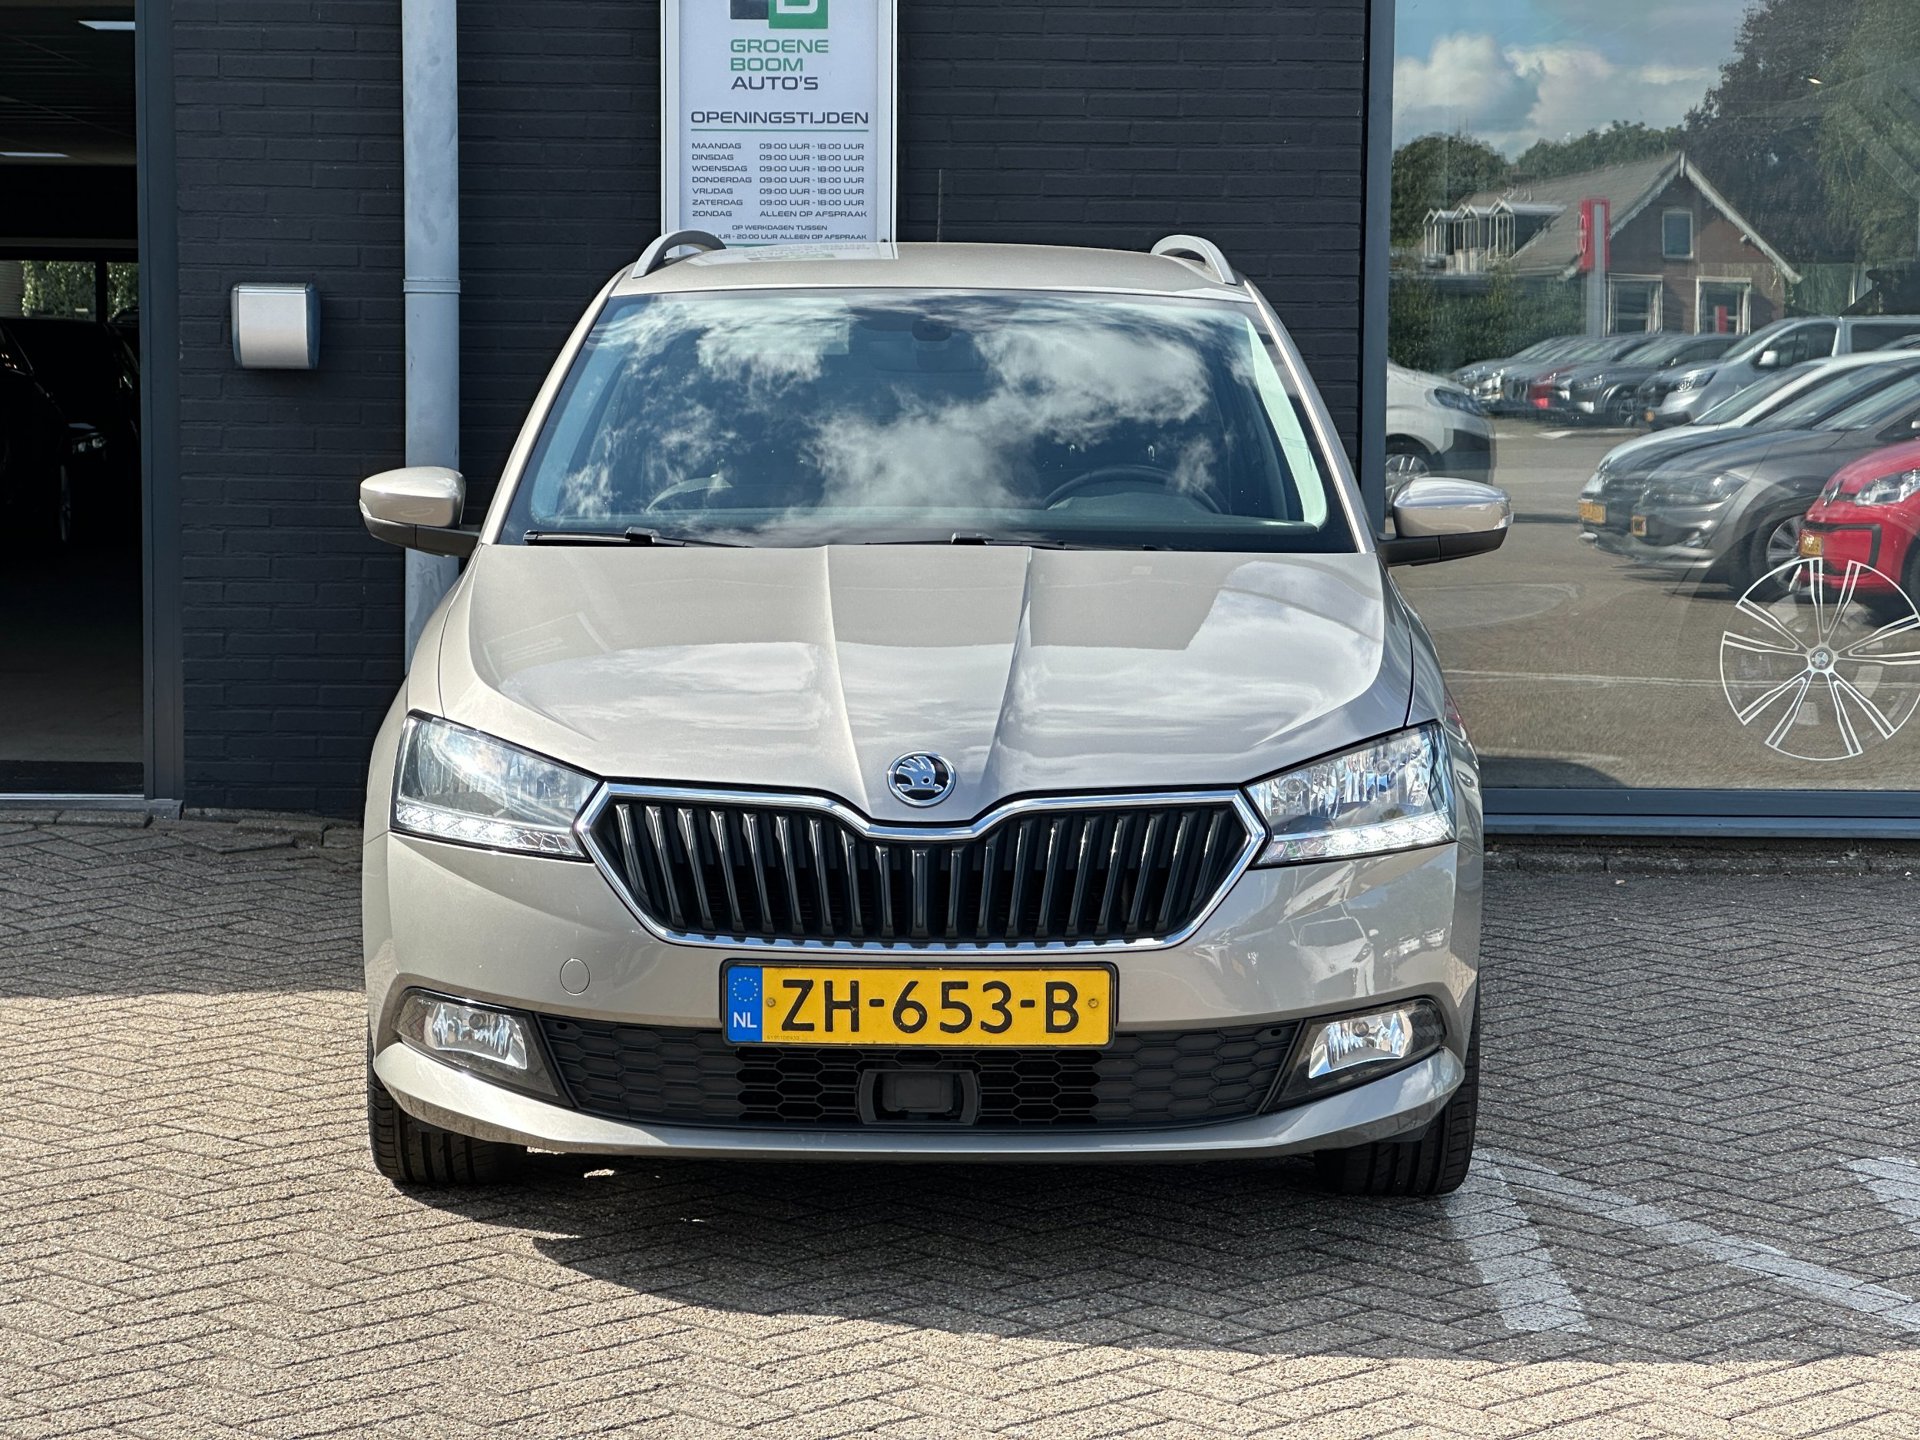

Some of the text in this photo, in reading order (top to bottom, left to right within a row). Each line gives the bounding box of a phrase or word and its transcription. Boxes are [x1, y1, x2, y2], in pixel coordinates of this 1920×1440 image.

[730, 39, 829, 54] GROENE
[730, 57, 804, 72] BOOM
[731, 75, 819, 91] AUTO'S
[690, 111, 869, 125] OPENINGSTIJDEN
[691, 142, 742, 150] MAANDAG
[789, 142, 811, 150] UUR
[843, 142, 865, 150] UUR
[691, 154, 734, 162] DINSDAG
[789, 154, 811, 162] UUR
[843, 154, 865, 162] UUR
[691, 165, 748, 173] WOENSDAG
[789, 165, 811, 173] UUR
[843, 165, 865, 173] UUR
[691, 176, 752, 184] DONDERDAG
[789, 176, 811, 184] UUR
[843, 176, 865, 184] UUR
[691, 188, 734, 196] VRIJDAG
[789, 188, 811, 196] UUR
[843, 188, 865, 196] UUR
[691, 199, 744, 207] ZATERDAG
[789, 199, 811, 207] UUR
[843, 199, 865, 207] UUR
[759, 210, 797, 218] ALLEEN
[799, 210, 813, 218] OP
[814, 210, 868, 218] AFSPRAAK
[733, 979, 1080, 1034] NL ZH-653-B
